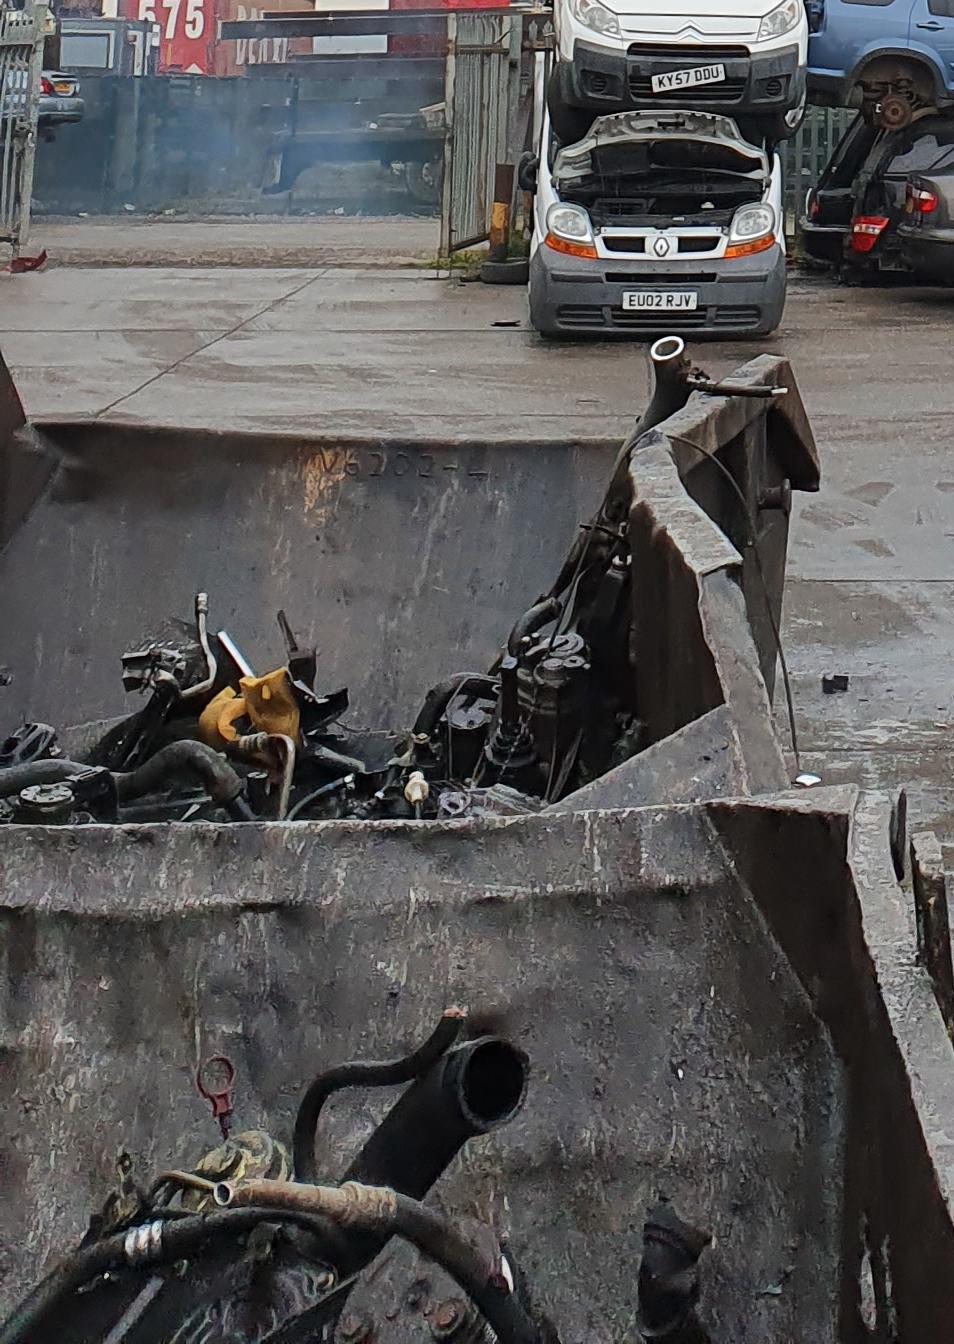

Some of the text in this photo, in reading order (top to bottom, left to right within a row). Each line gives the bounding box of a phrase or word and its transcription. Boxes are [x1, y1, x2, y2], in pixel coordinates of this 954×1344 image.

[658, 67, 720, 88] KY57 DDU
[629, 295, 691, 307] EU02 RJV
